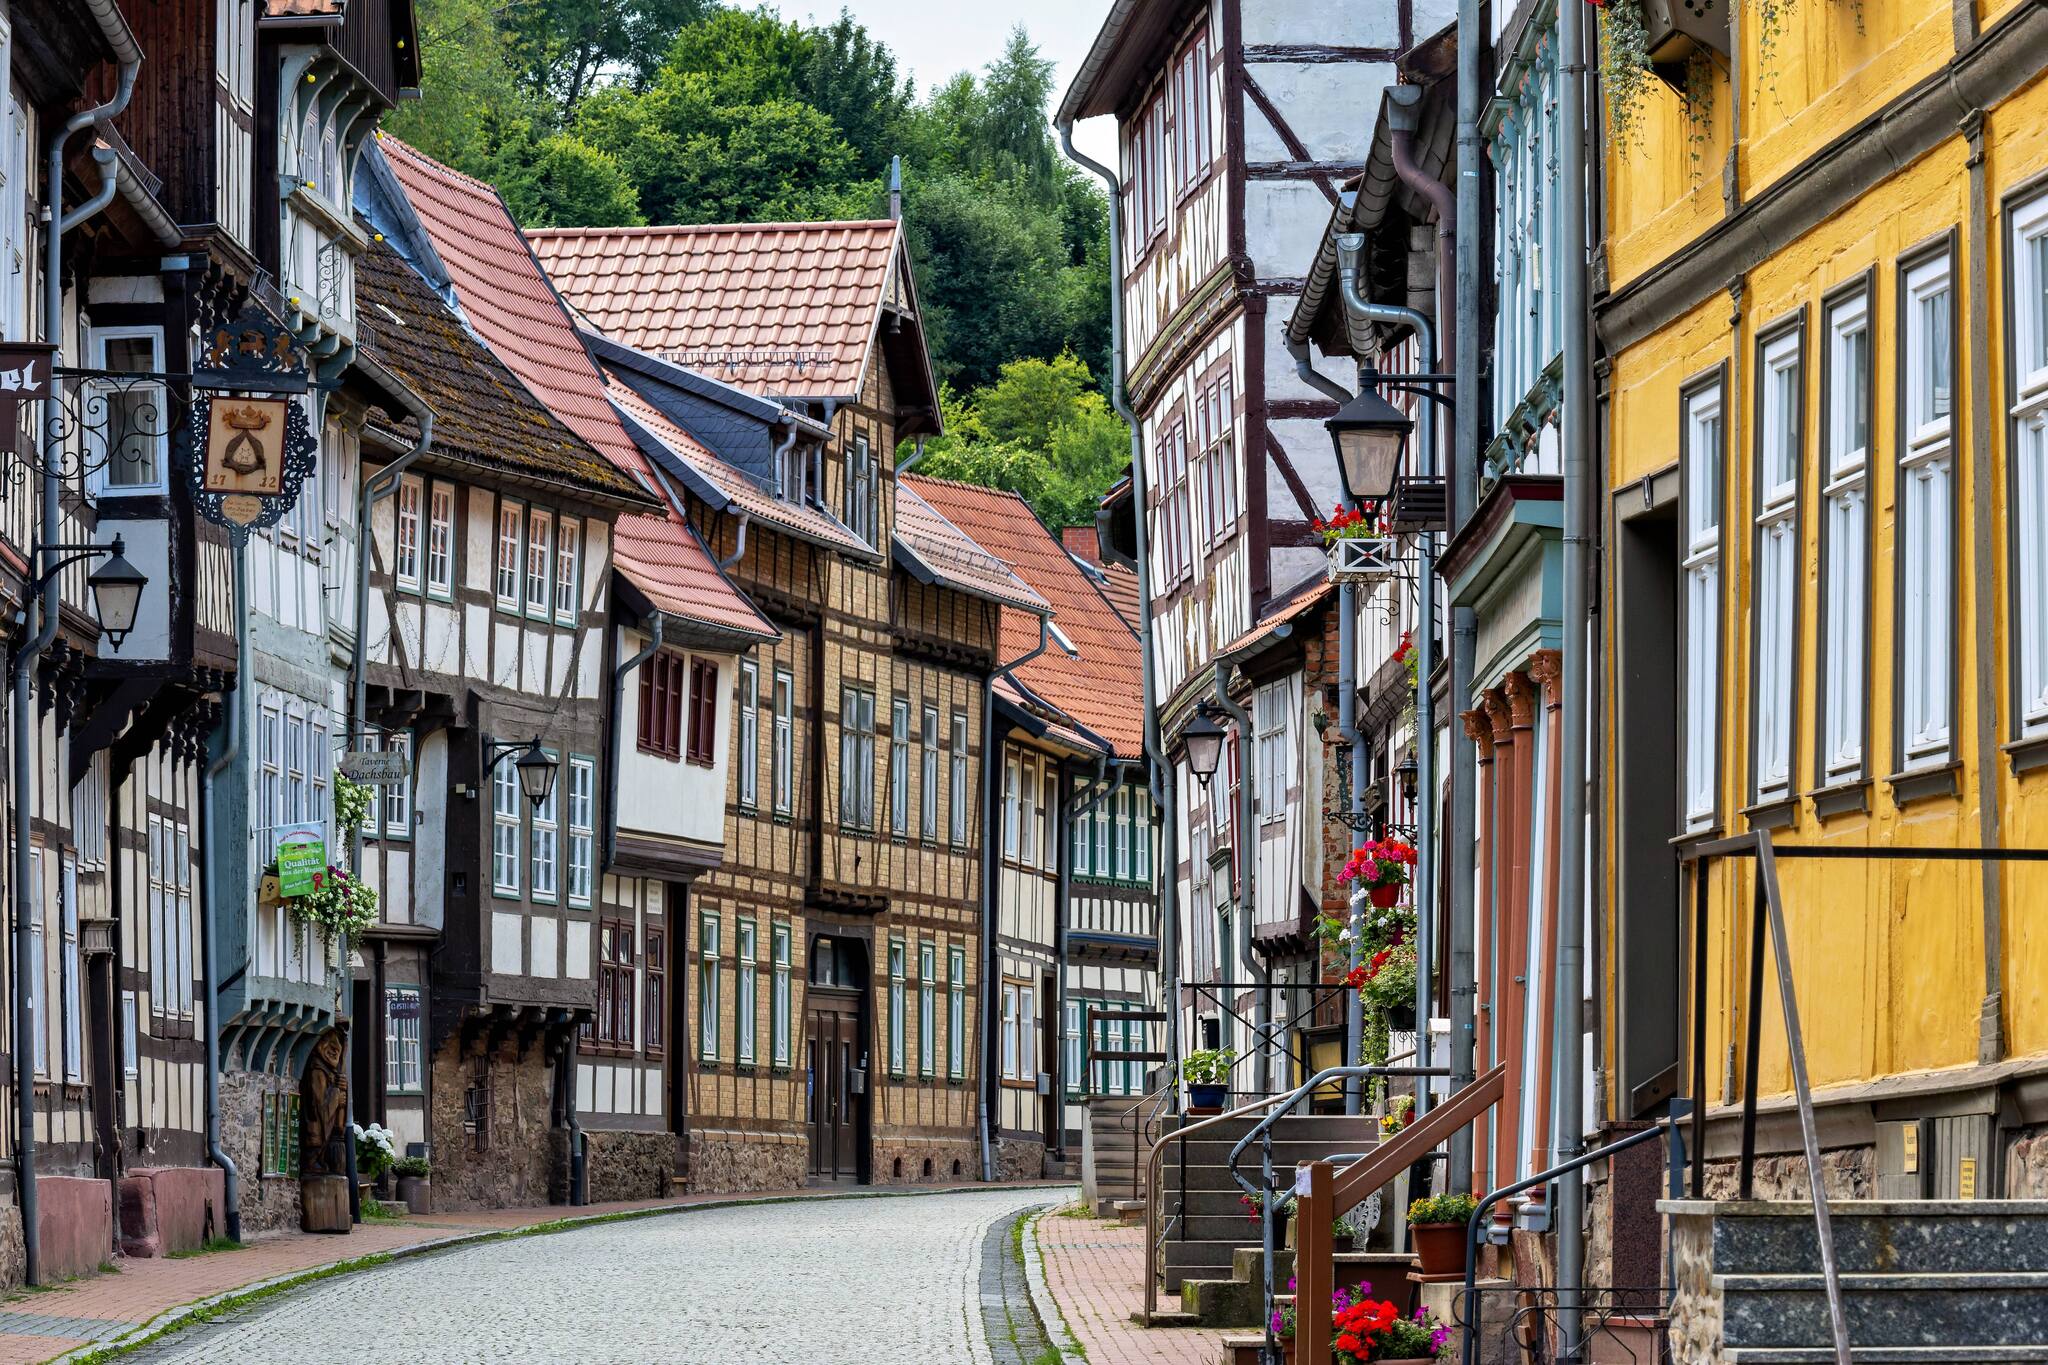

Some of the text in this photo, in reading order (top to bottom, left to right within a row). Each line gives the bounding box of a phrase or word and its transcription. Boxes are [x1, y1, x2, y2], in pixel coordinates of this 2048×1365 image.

[211, 474, 226, 486] 17
[360, 757, 390, 766] Taverne
[351, 767, 401, 780] Dachsbau
[284, 858, 320, 869] Qualität
